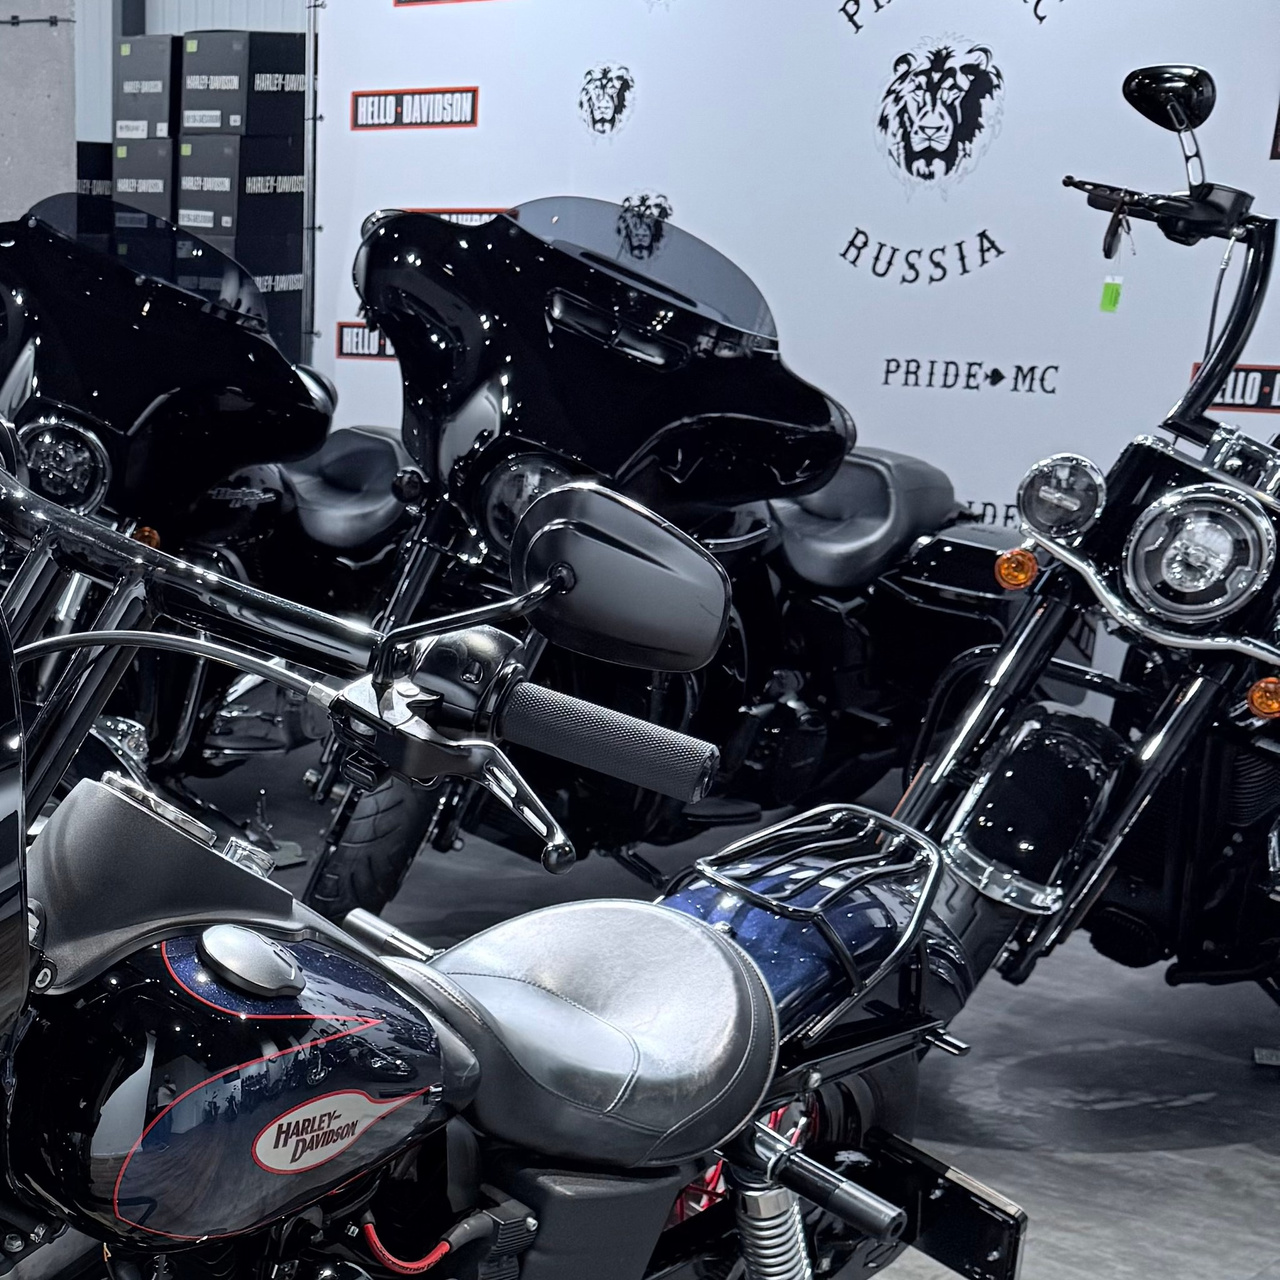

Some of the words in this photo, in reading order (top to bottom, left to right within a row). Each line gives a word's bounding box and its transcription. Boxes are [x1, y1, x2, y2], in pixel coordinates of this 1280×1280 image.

[357, 95, 396, 125] HELLO
[402, 92, 472, 124] DAVIDSON
[839, 227, 1006, 285] RUSSIA
[342, 327, 379, 355] HELLO
[882, 358, 984, 391] PRIDE
[1010, 365, 1059, 394] MC
[273, 1110, 342, 1149] HARLEY-
[290, 1120, 359, 1164] DAVIDSON
